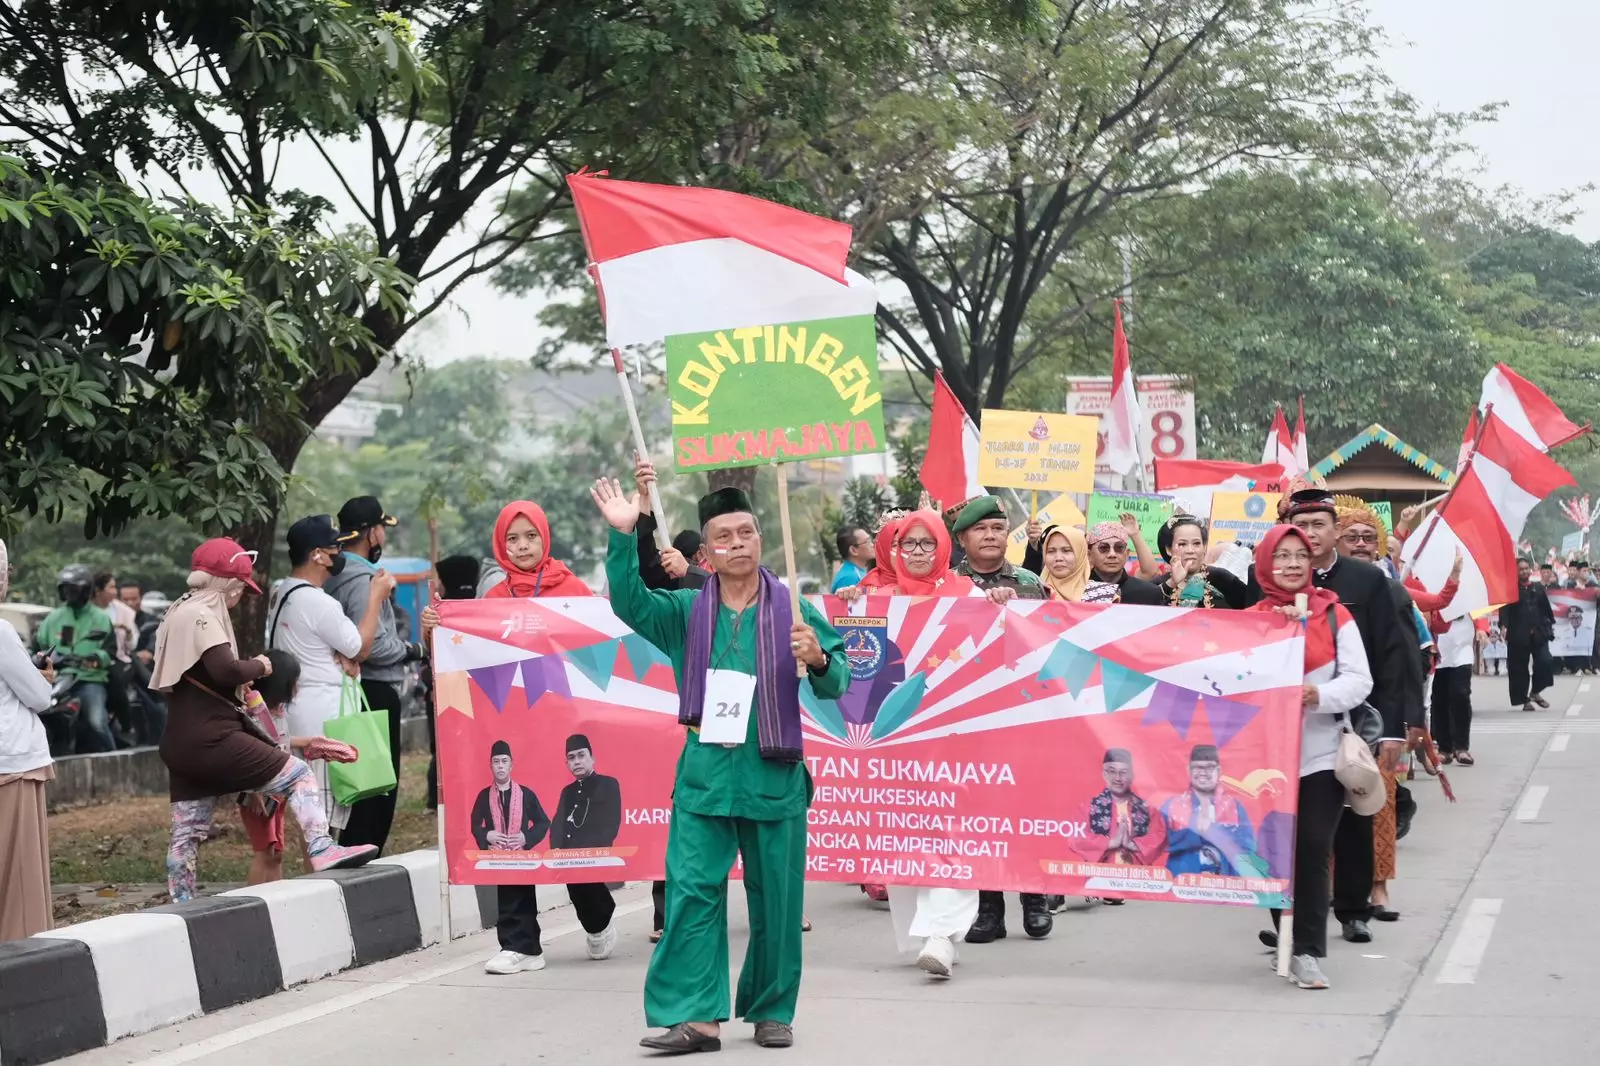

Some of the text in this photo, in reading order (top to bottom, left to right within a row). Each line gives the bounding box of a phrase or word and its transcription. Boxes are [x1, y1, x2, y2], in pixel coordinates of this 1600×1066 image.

[672, 325, 881, 425] KONTINGEN
[677, 419, 877, 468] SUKMAJAYA
[1151, 410, 1185, 458] 8
[715, 702, 741, 718] 24
[867, 759, 1016, 786] SUKMAJAYA
[876, 811, 955, 832] TINGKAT
[960, 816, 1014, 834] KOTA
[1019, 819, 1087, 839] DEPOK
[866, 835, 1009, 859] MEMPERINGATI
[806, 855, 973, 880] KE-78 TAHUN 2023
